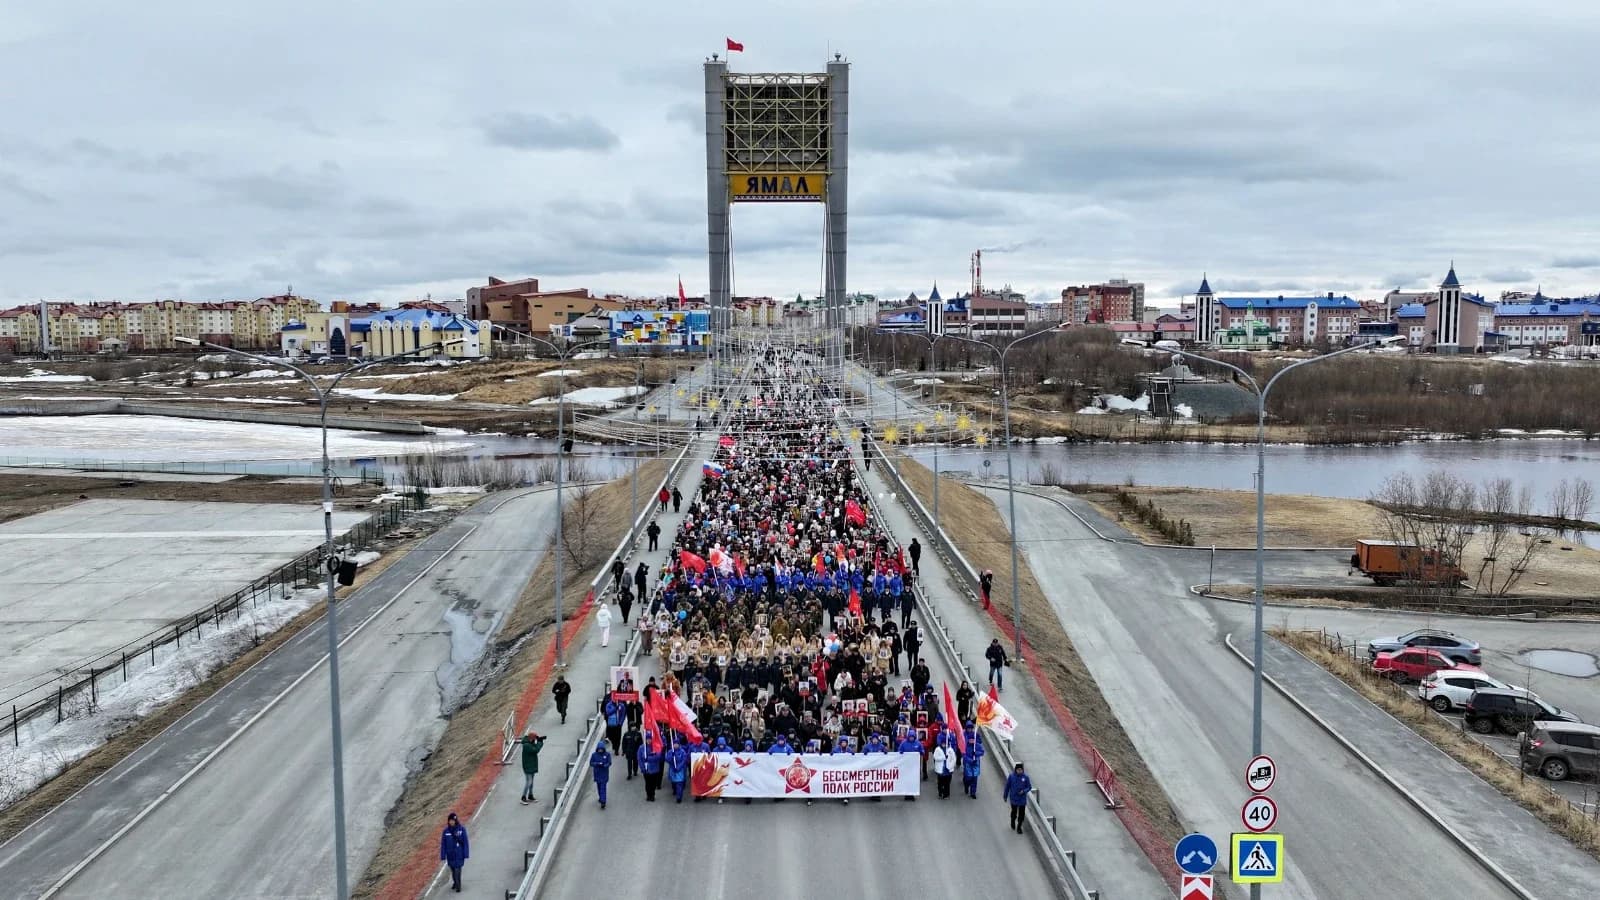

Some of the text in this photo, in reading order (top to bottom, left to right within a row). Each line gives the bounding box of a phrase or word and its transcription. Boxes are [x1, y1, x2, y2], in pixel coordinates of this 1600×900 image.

[747, 176, 809, 193] ЯМАЛ
[822, 766, 899, 782] БЕССМЕРТНЫЙ
[823, 781, 894, 794] ПОЛК РОССИИ
[1249, 806, 1271, 821] 40
